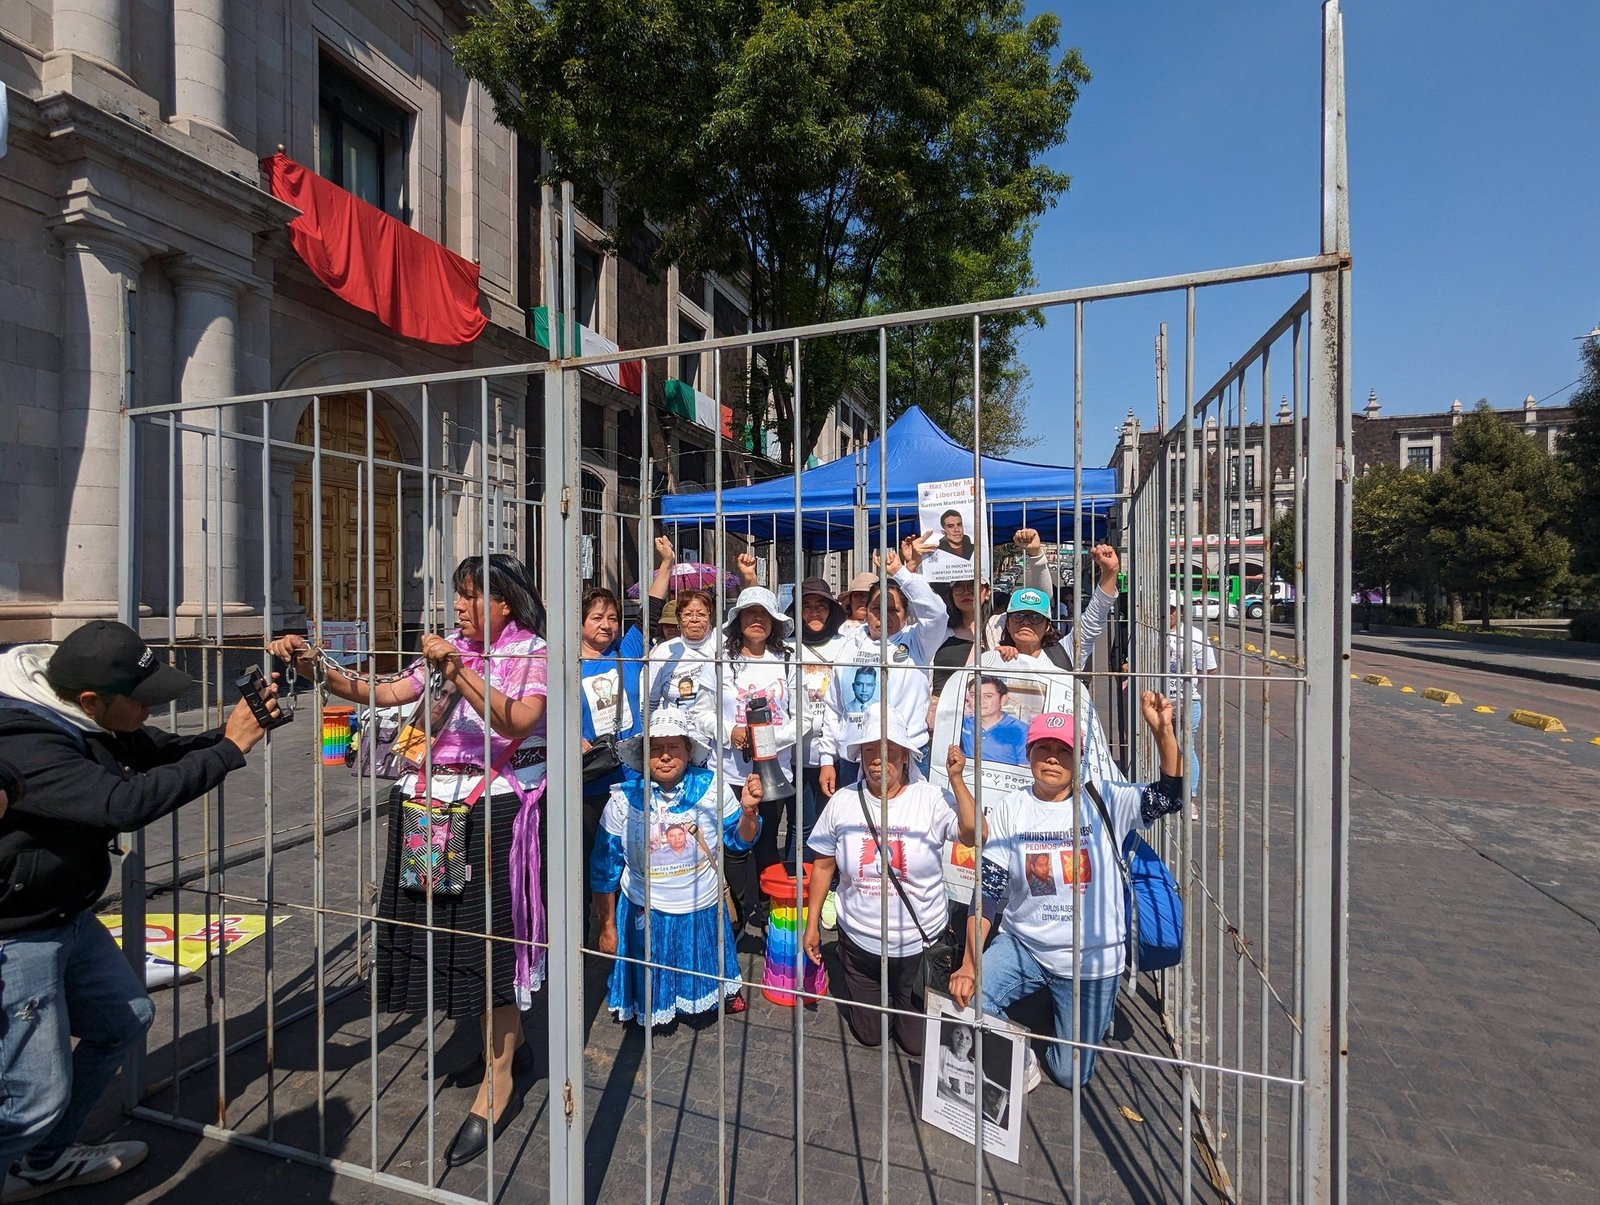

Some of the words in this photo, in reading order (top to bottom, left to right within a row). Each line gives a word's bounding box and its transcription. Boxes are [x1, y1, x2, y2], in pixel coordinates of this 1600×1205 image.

[935, 490, 965, 499] Libertad
[1021, 594, 1040, 602] Jeep
[138, 647, 153, 667] CHICA
[1025, 843, 1057, 851] PEDIMOS
[1042, 904, 1060, 912] CARLOS
